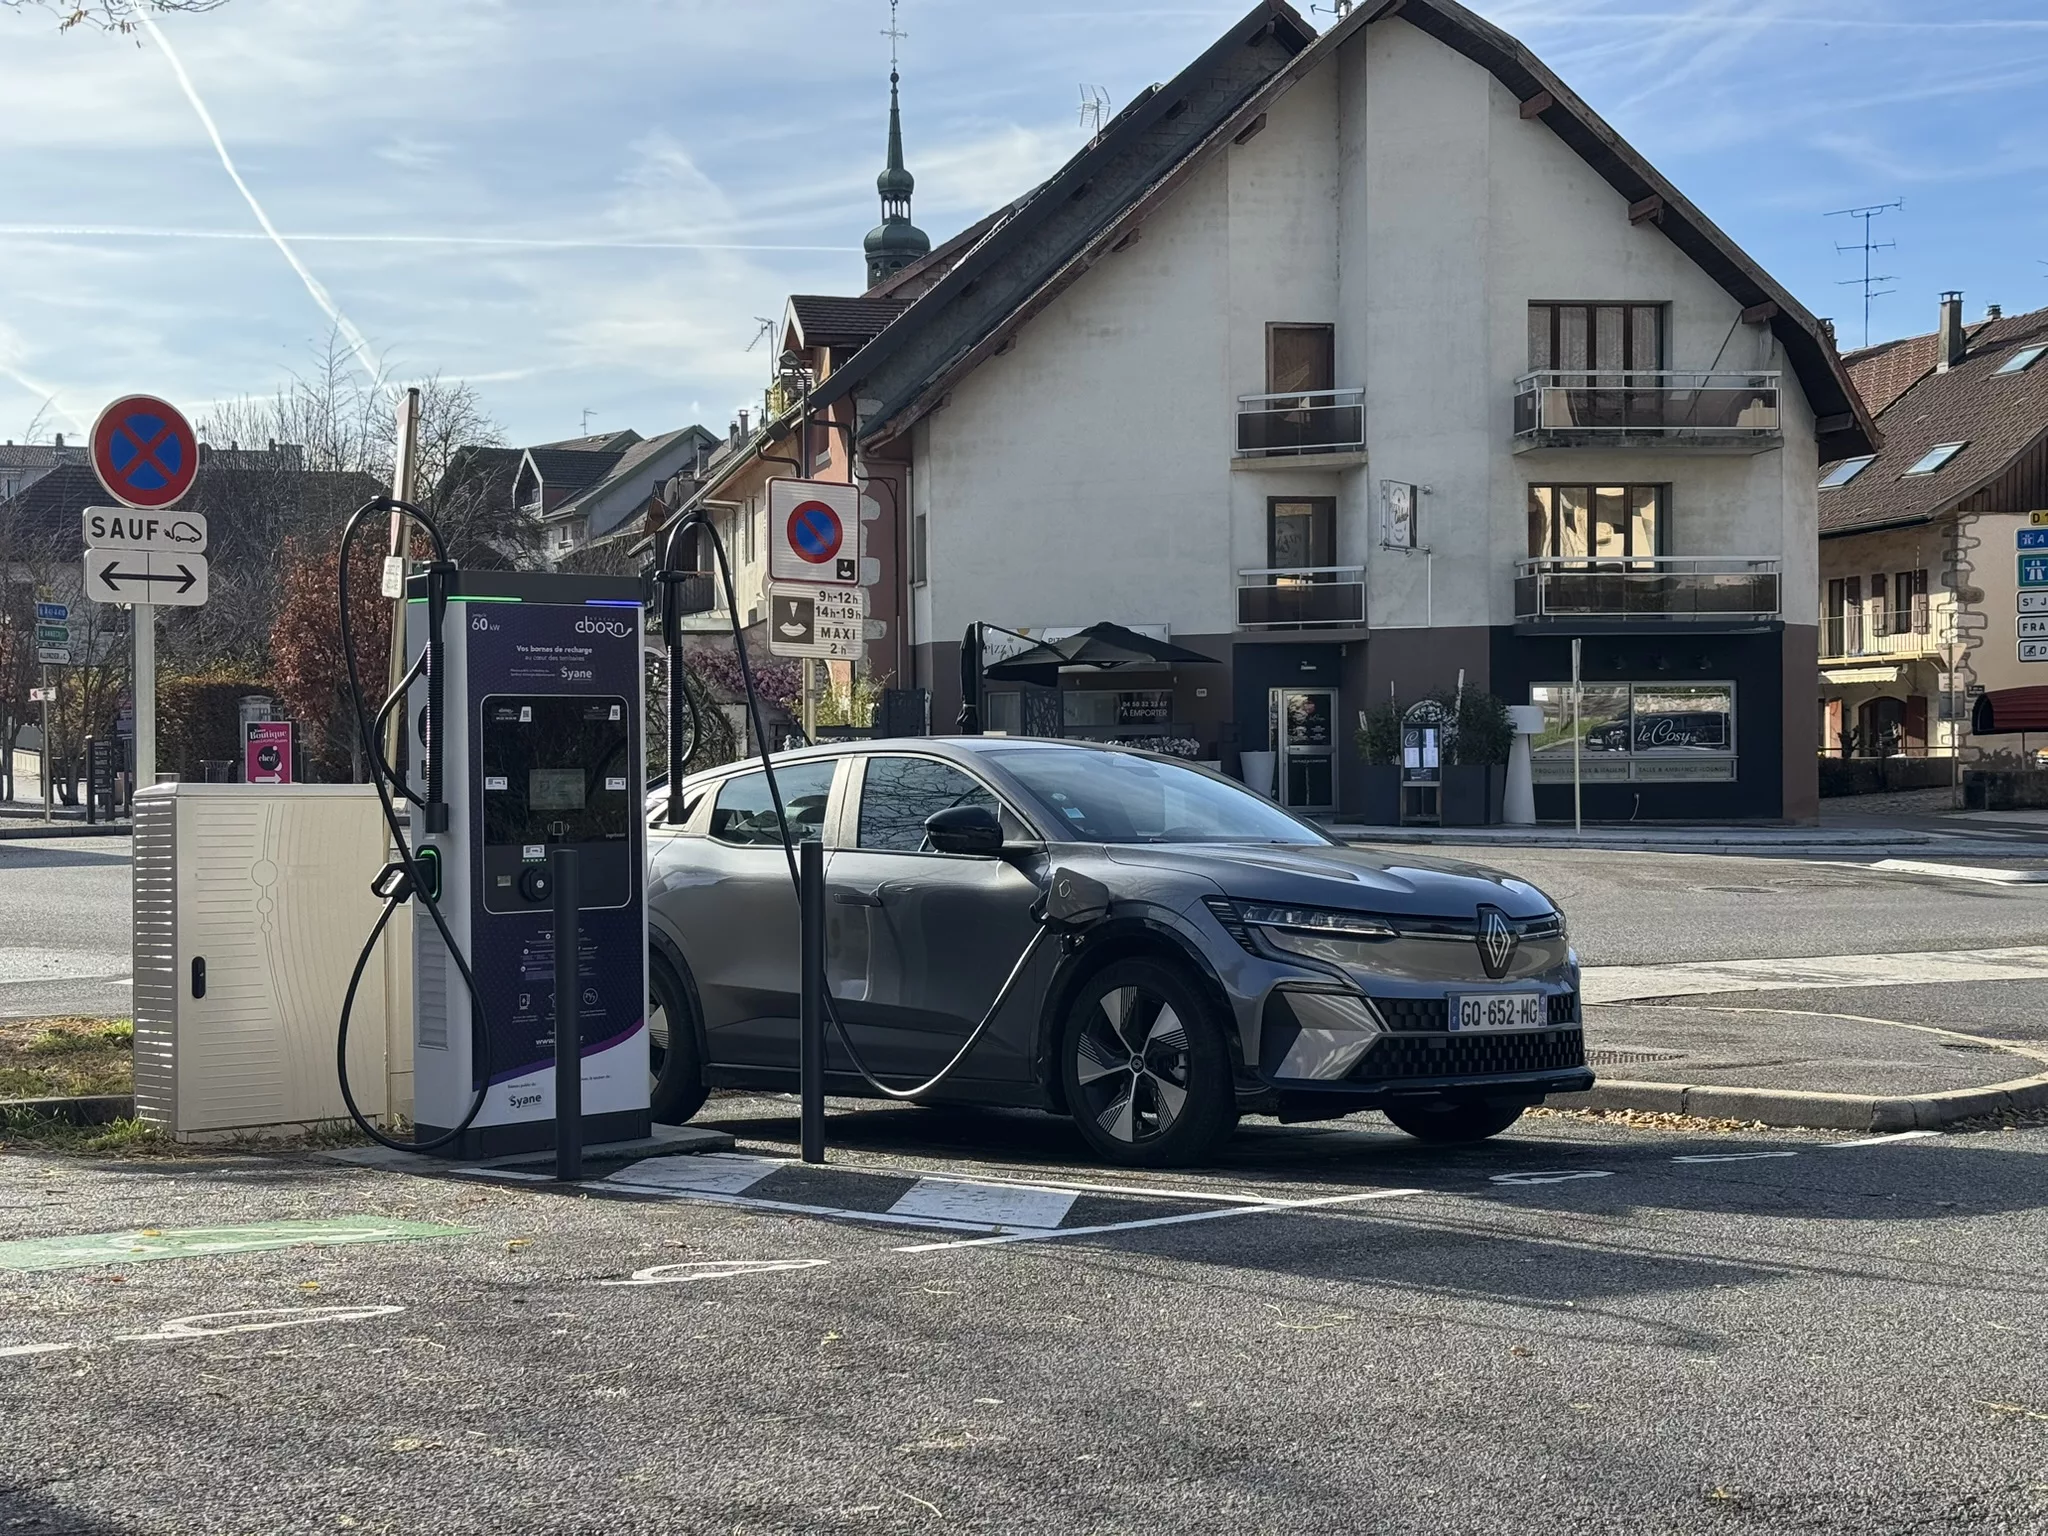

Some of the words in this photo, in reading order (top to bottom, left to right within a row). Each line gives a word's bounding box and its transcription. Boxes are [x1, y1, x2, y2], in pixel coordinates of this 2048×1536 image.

[91, 516, 159, 541] SAUF
[819, 590, 859, 605] 9h-12h
[815, 605, 861, 619] 14h-19h
[472, 618, 488, 631] 60
[575, 616, 631, 637] eborn
[820, 627, 856, 640] MAXI
[554, 645, 563, 653] de
[564, 646, 593, 655] recharge
[830, 643, 837, 653] 2
[841, 644, 847, 655] h
[560, 667, 592, 680] Syane
[250, 730, 287, 739] Boutique
[1651, 719, 1691, 745] Cosy
[509, 1095, 542, 1108] Syane
